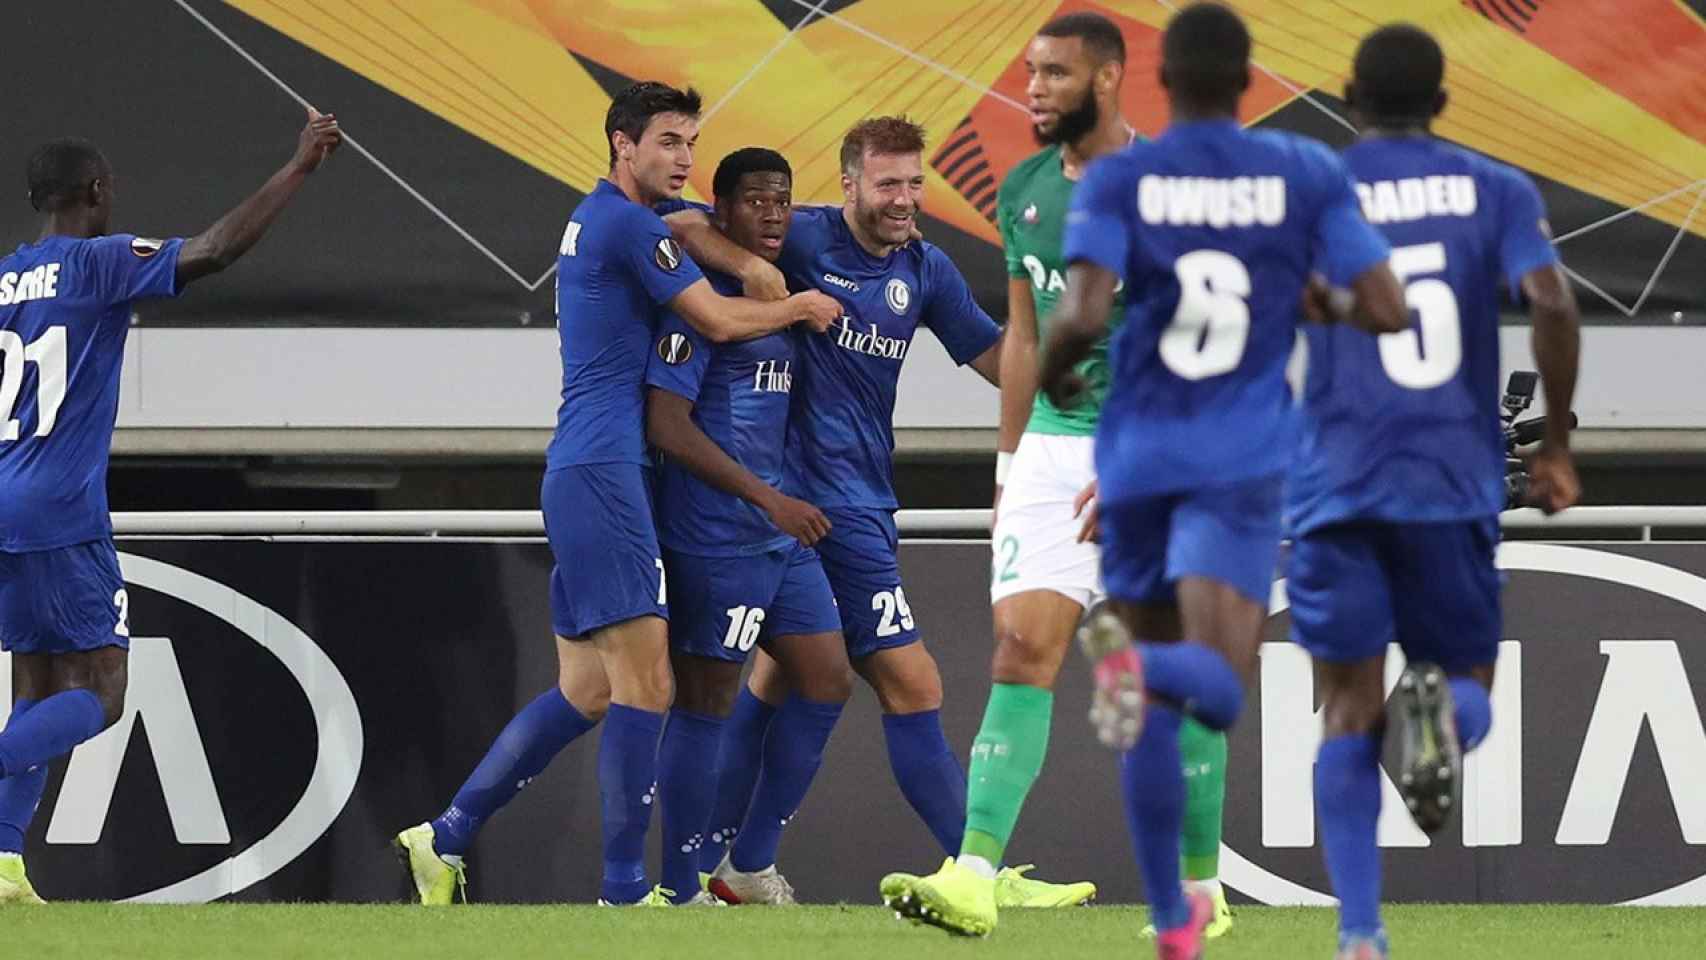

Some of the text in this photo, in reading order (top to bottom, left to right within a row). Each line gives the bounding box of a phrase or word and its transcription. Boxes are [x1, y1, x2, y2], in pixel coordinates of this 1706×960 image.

[1137, 174, 1286, 228] OWUSU
[0, 263, 60, 305] SARE
[1158, 249, 1252, 381] 6
[1377, 241, 1463, 389] 5
[0, 325, 67, 441] 21
[1000, 534, 1020, 584] 2
[113, 588, 129, 637] 2
[723, 605, 765, 651] 16
[872, 586, 914, 637] 29
[1259, 640, 1706, 847] KIA
